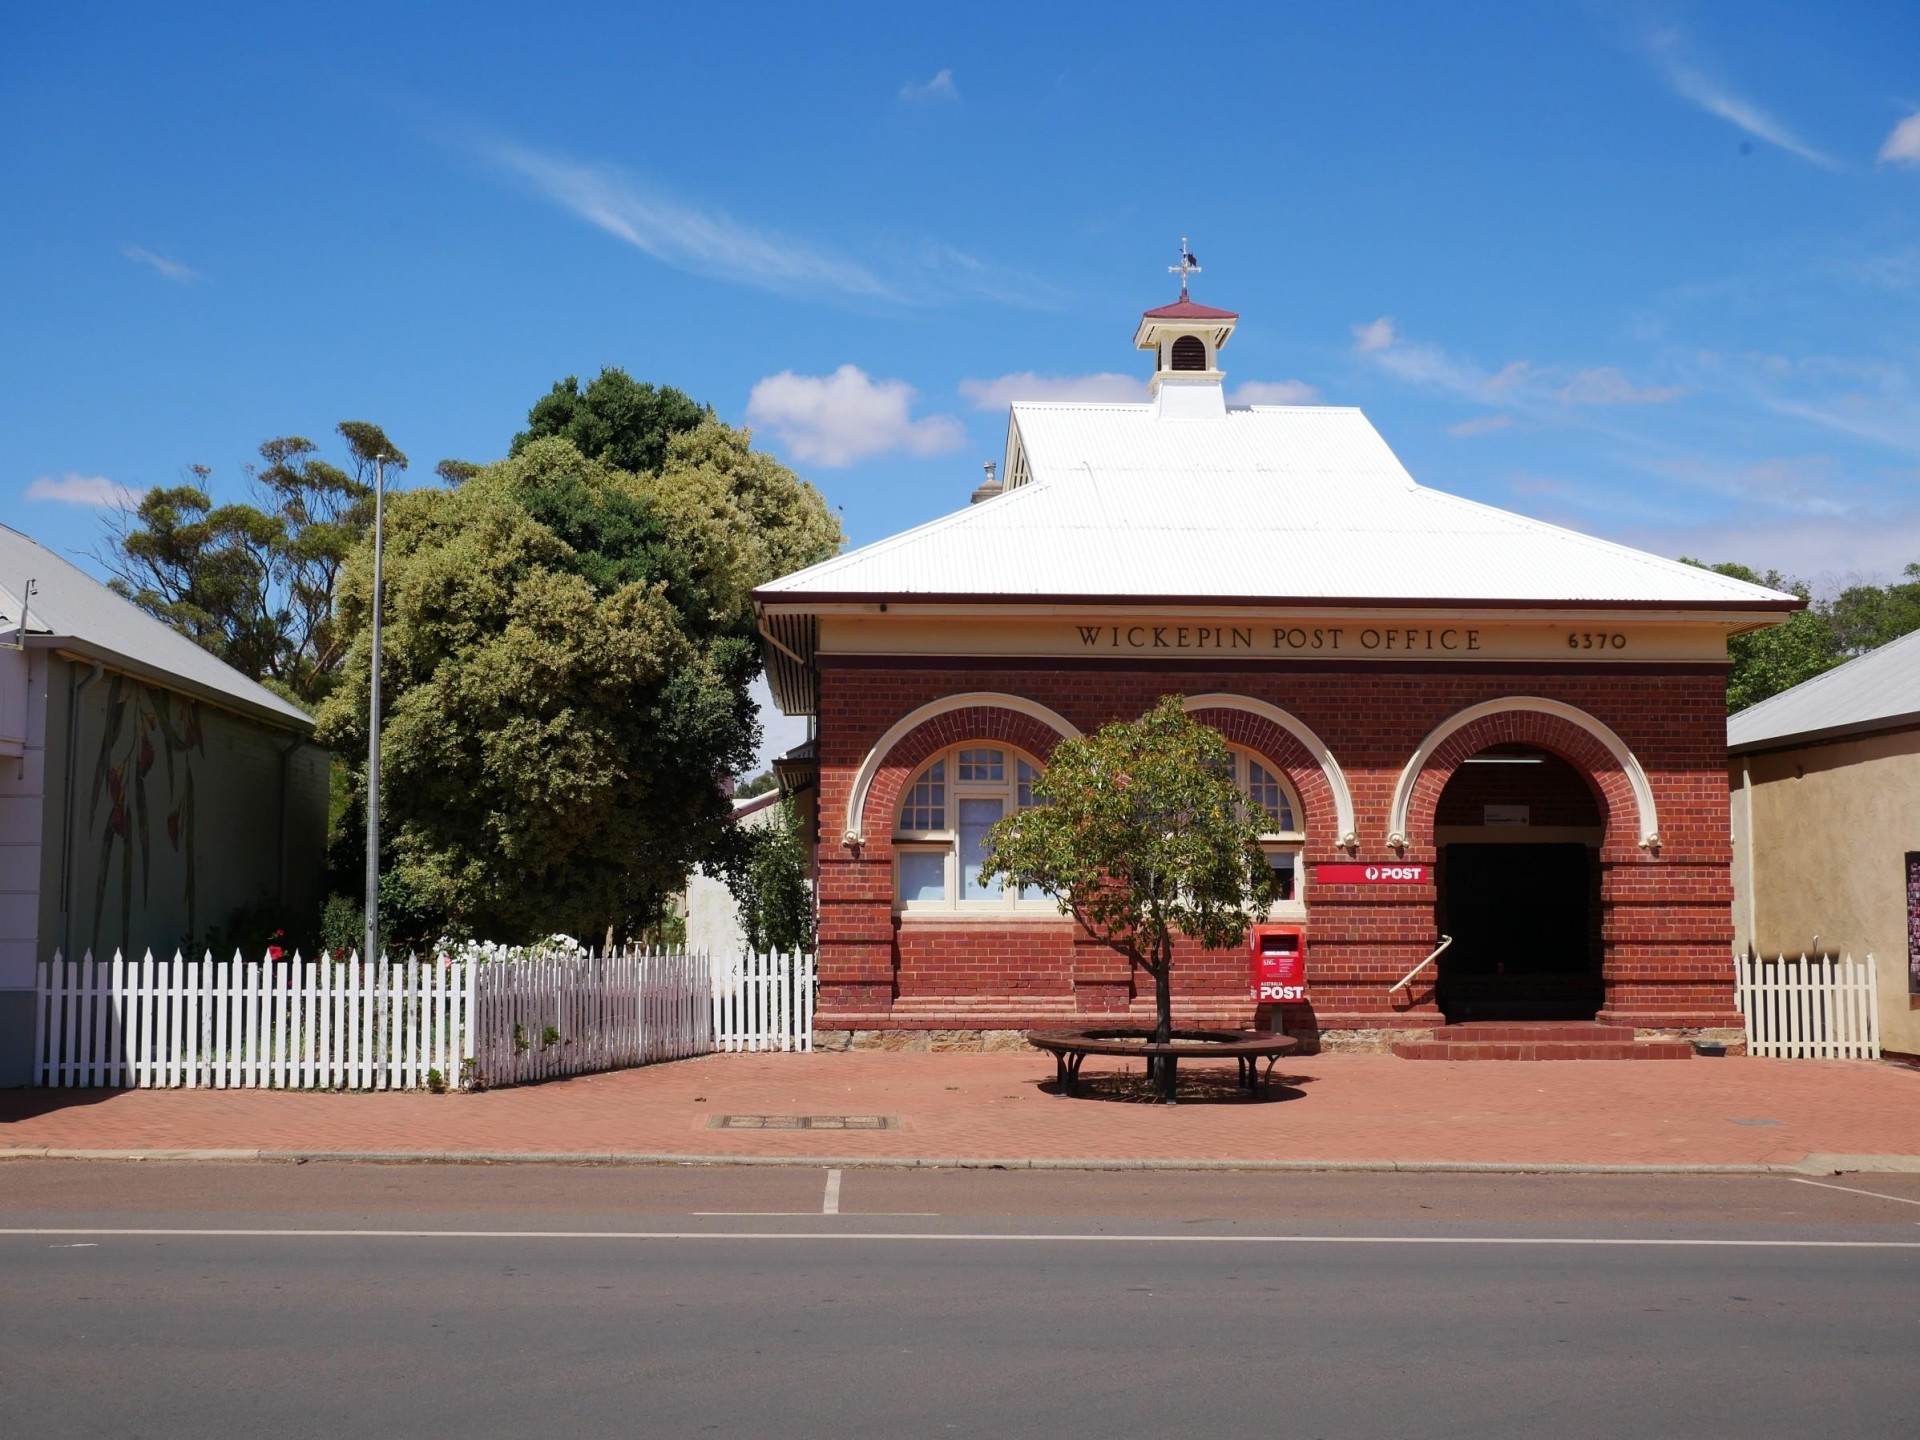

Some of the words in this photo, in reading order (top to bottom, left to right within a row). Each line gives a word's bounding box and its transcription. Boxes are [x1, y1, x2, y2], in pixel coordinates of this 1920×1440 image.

[1077, 626, 1254, 649] WICKEPIN
[1272, 628, 1344, 650] POST
[1359, 629, 1482, 651] OFFICE
[1567, 632, 1627, 650] 6370
[1381, 867, 1422, 880] POST
[1260, 986, 1304, 1000] POST
